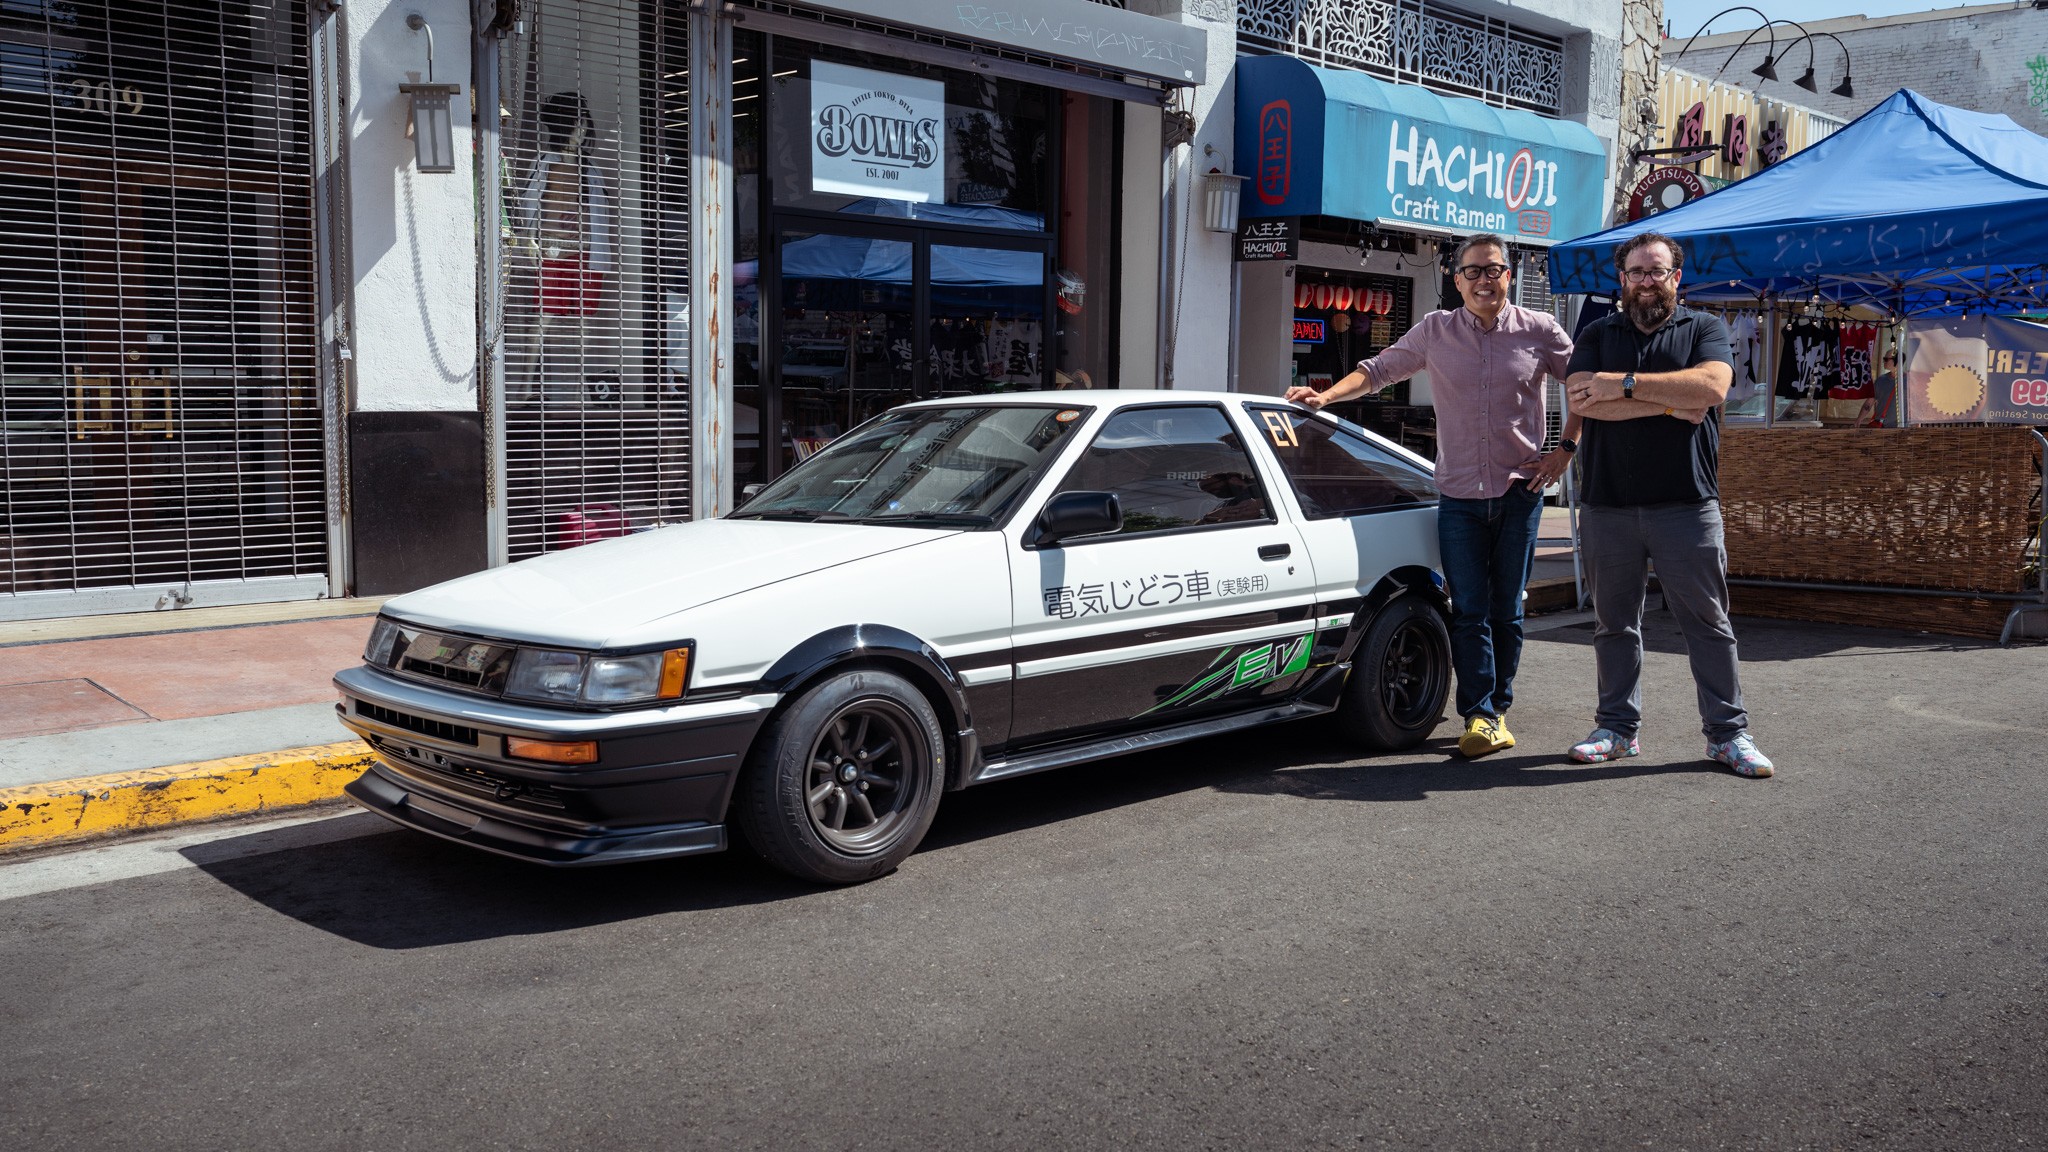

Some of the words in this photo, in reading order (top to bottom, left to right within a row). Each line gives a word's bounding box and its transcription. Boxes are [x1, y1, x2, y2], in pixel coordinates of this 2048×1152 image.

[71, 79, 143, 117] 309
[851, 91, 871, 107] LITTLE
[899, 98, 914, 116] DTLA
[816, 104, 939, 170] BOWLS
[1264, 112, 1287, 190] 八王子
[866, 167, 880, 179] EST.
[882, 169, 899, 181] 2007
[1386, 119, 1558, 213] HACHIOJI
[1667, 157, 1682, 165] 315
[1635, 168, 1700, 197] FUGETSU-DO
[1245, 222, 1288, 237] 八王子
[1391, 193, 1440, 221] Craft
[1446, 201, 1505, 231] Ramen
[1242, 241, 1287, 254] HACHIOJI
[1260, 411, 1299, 446] EV
[1166, 471, 1207, 480] BRIDE
[1044, 569, 1211, 619] 電気じどう車
[1228, 637, 1305, 690] EV
